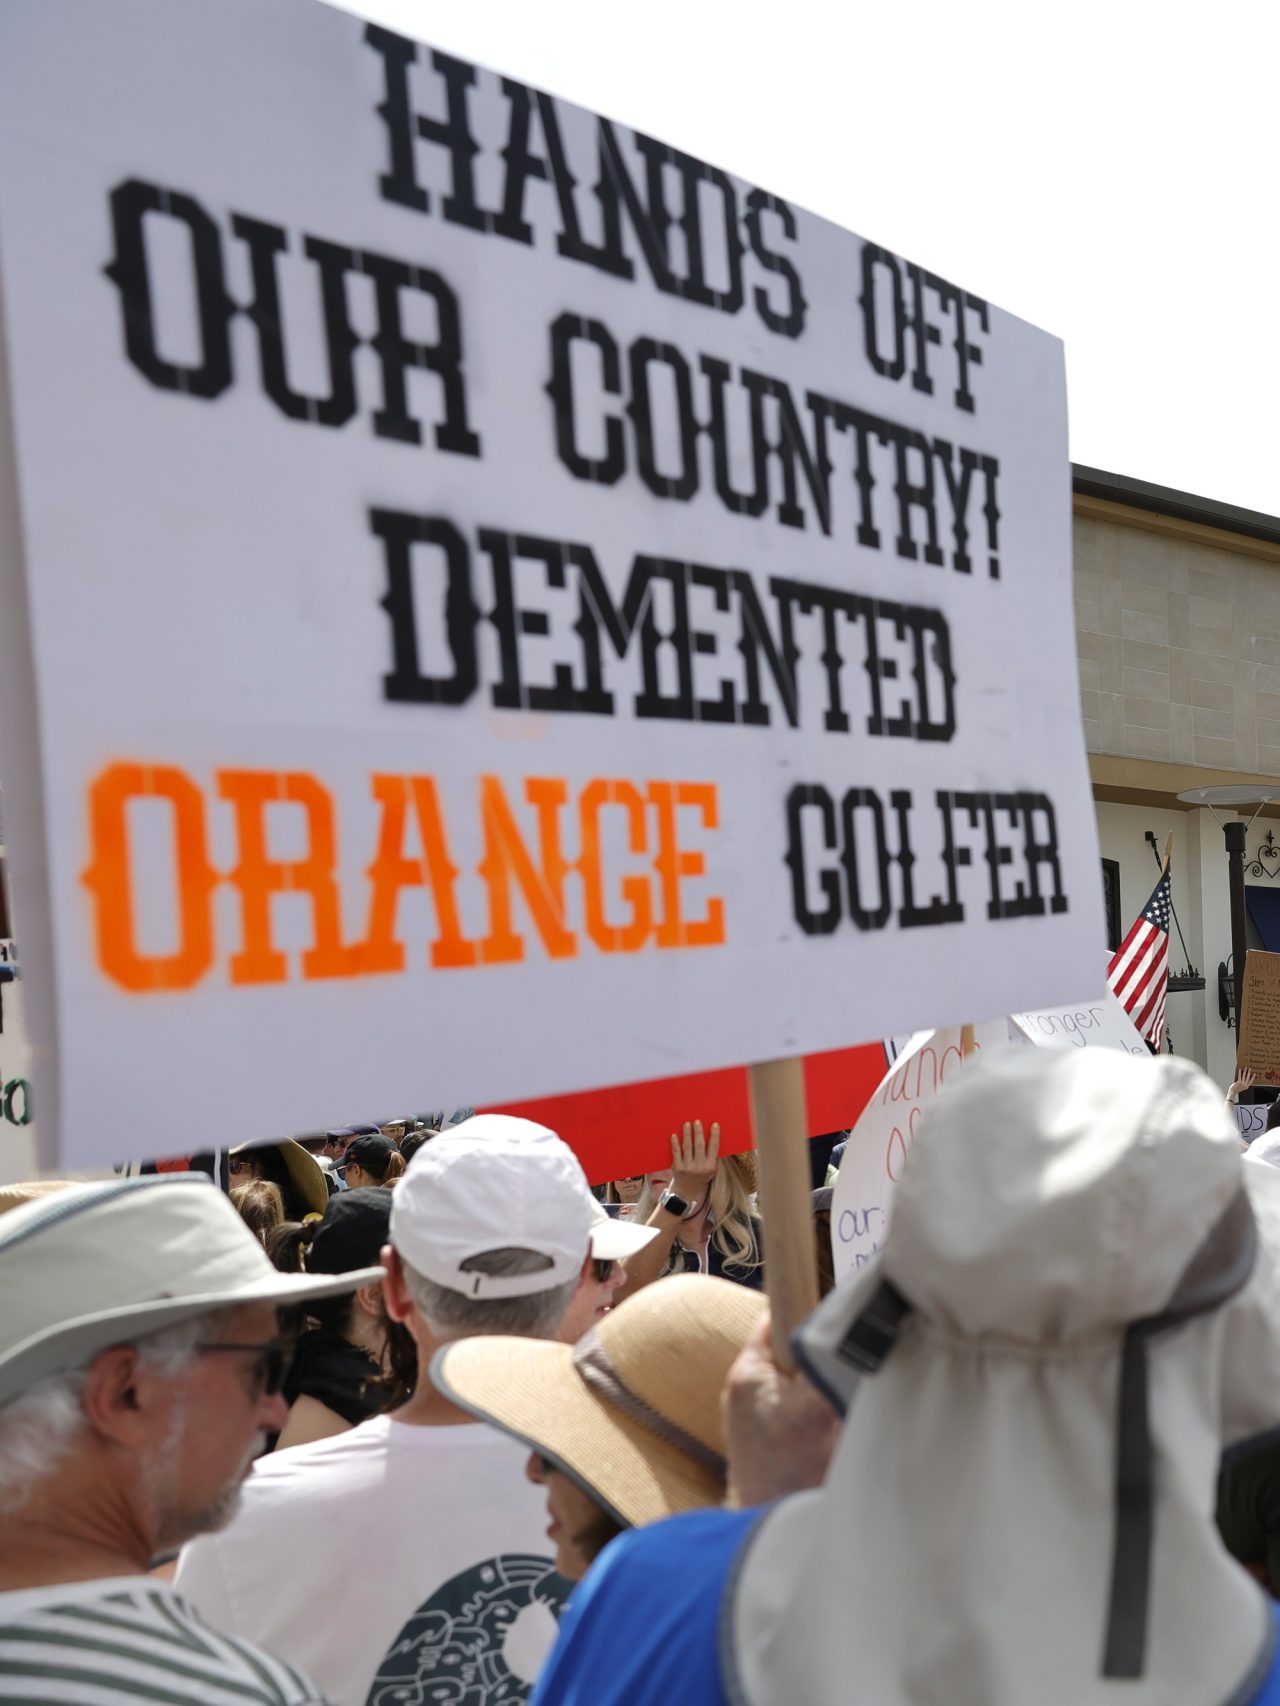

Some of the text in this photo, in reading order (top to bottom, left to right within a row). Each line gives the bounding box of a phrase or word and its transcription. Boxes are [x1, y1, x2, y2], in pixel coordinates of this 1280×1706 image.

[364, 22, 990, 413] HANDS OFF
[103, 178, 1001, 579] OUR COUNTRY!
[367, 506, 956, 742] DEMENTED
[80, 759, 1069, 994] ORANGE GOLFER
